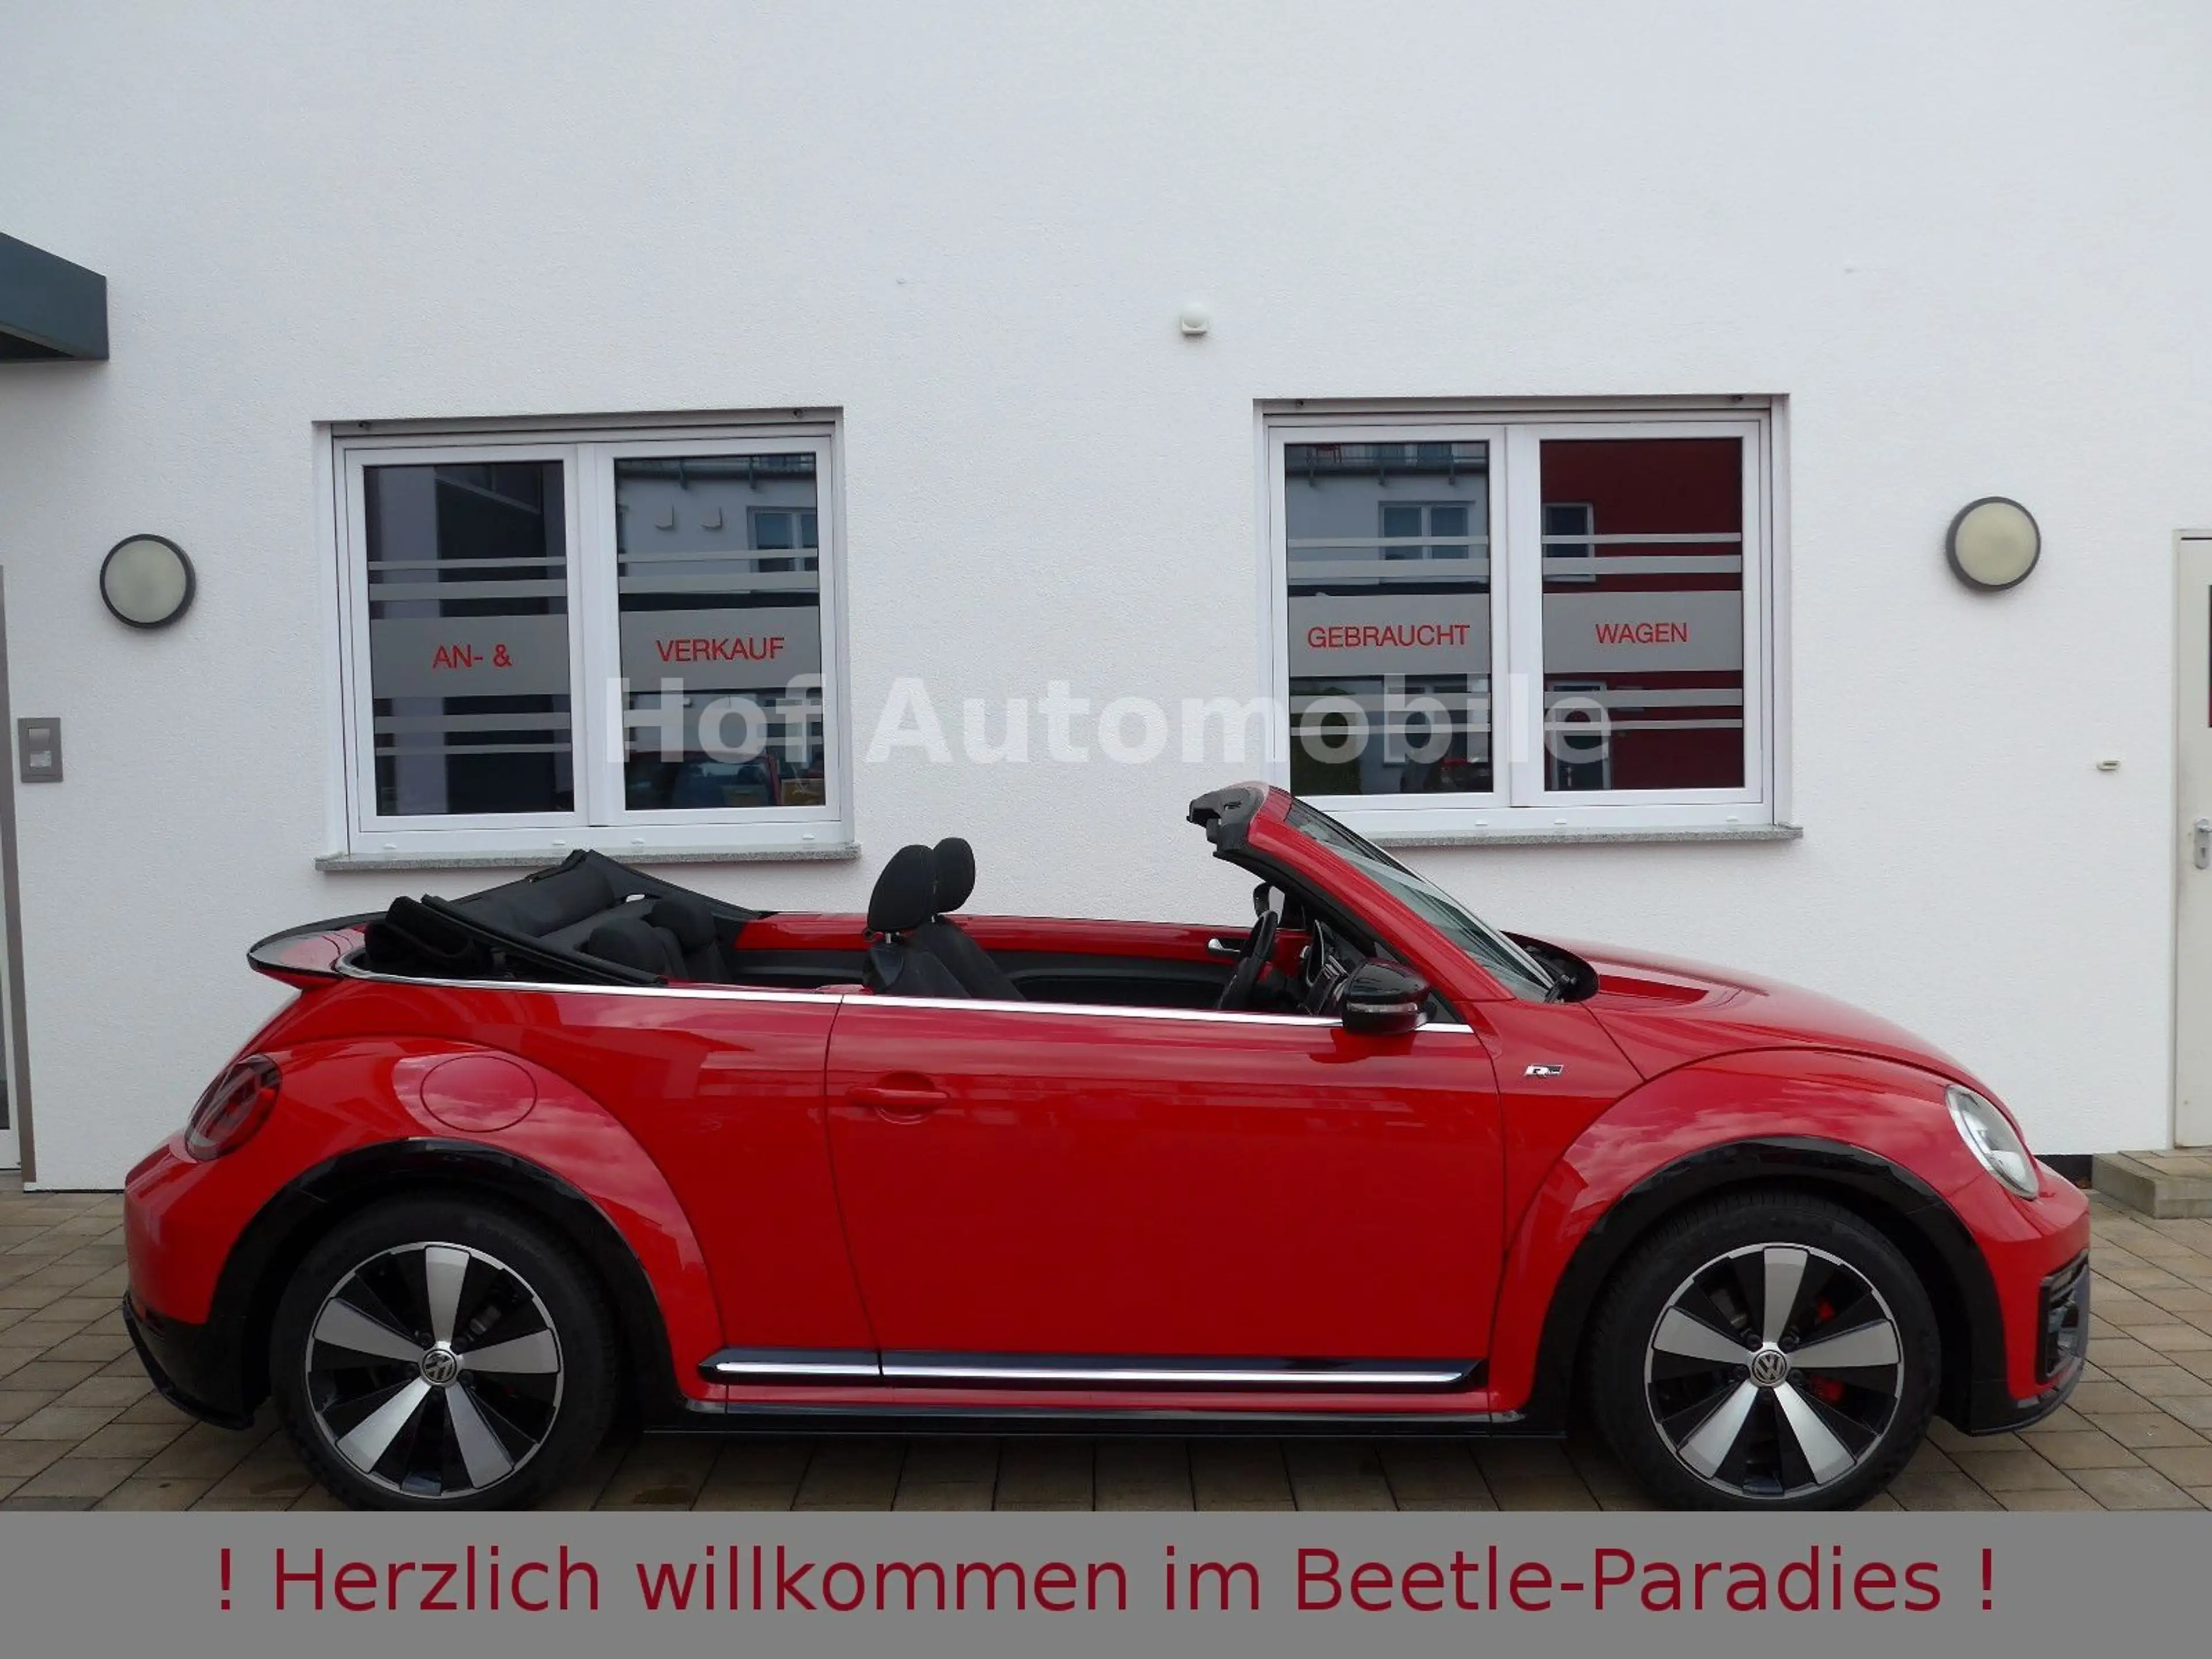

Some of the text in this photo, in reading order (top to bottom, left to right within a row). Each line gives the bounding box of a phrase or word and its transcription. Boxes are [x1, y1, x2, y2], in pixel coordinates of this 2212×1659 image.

[1308, 624, 1469, 648] GEBRAUCHT
[1596, 623, 1689, 644] WAGEN
[432, 643, 513, 669] AN- &
[656, 637, 785, 663] VERKAUF
